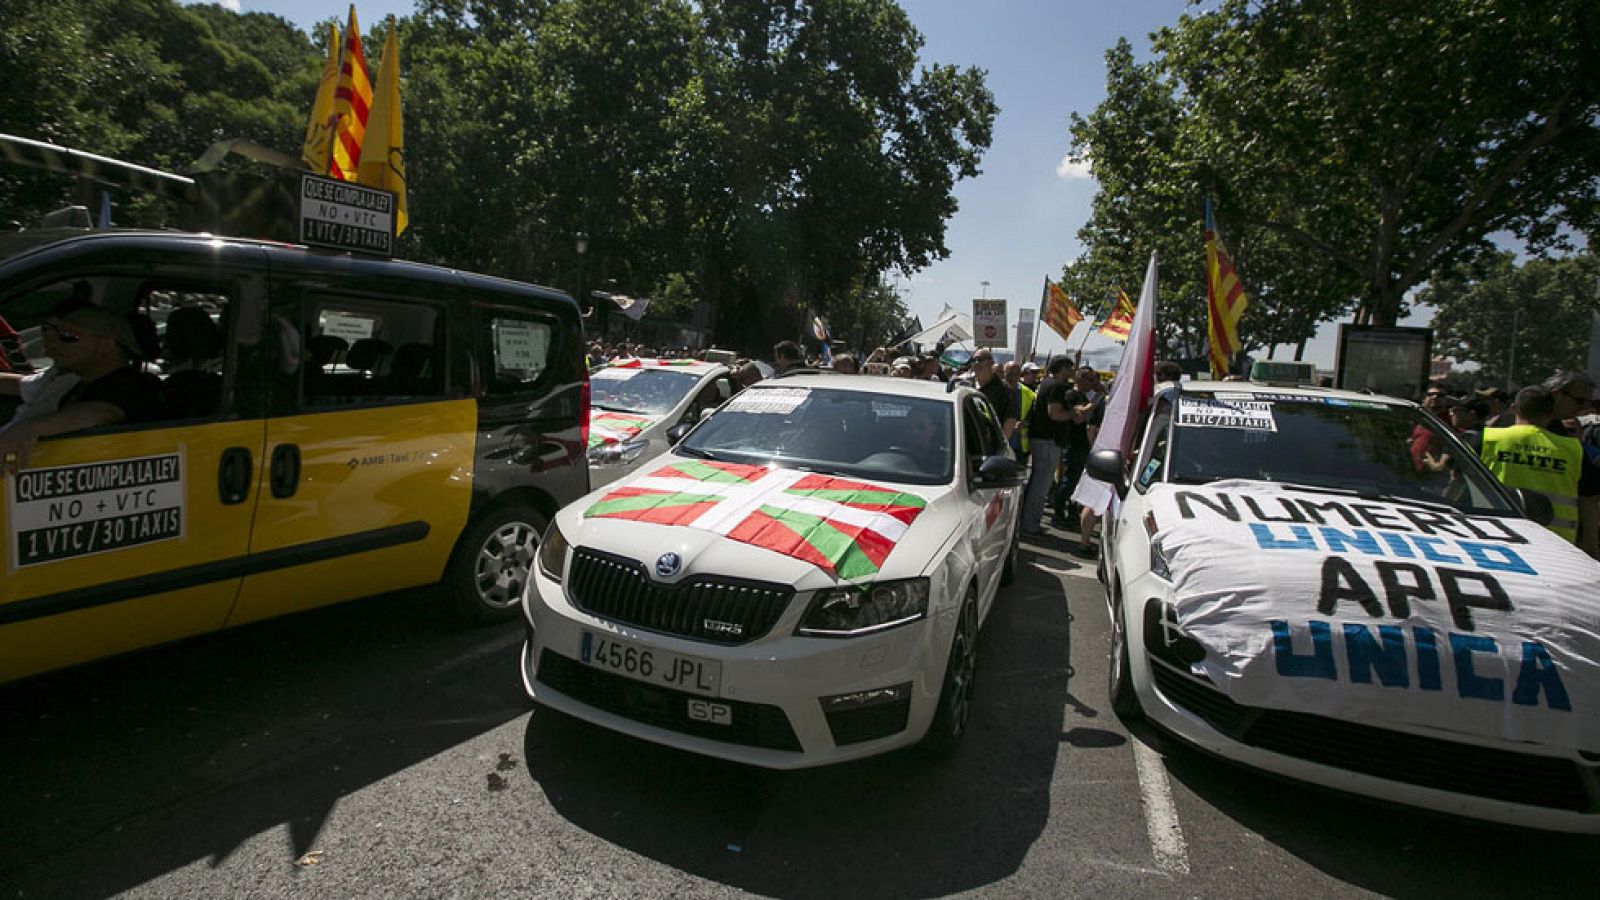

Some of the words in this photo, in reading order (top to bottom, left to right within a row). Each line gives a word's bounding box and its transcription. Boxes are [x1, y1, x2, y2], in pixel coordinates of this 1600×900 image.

[319, 203, 337, 219] NO
[354, 209, 377, 226] VTC
[1195, 415, 1214, 424] VTC
[1240, 416, 1270, 428] TAXIS
[19, 472, 53, 501] QUE
[56, 469, 74, 494] SE
[77, 463, 135, 491] CUMPLA
[137, 460, 153, 484] LA
[156, 458, 177, 481] LEY
[1497, 451, 1567, 471] ELITE
[50, 500, 83, 522] NO
[116, 489, 157, 512] VTC
[1175, 490, 1530, 545] NUMERO
[28, 533, 39, 557] 1
[46, 525, 84, 553] VTC
[103, 517, 125, 545] 30
[130, 509, 178, 540] TAXIS
[1248, 522, 1539, 576] UNICO
[1317, 555, 1515, 631] APP
[595, 639, 654, 677] 4566
[663, 657, 712, 691] JPL
[1270, 619, 1573, 712] UNICA
[691, 703, 727, 722] SP
